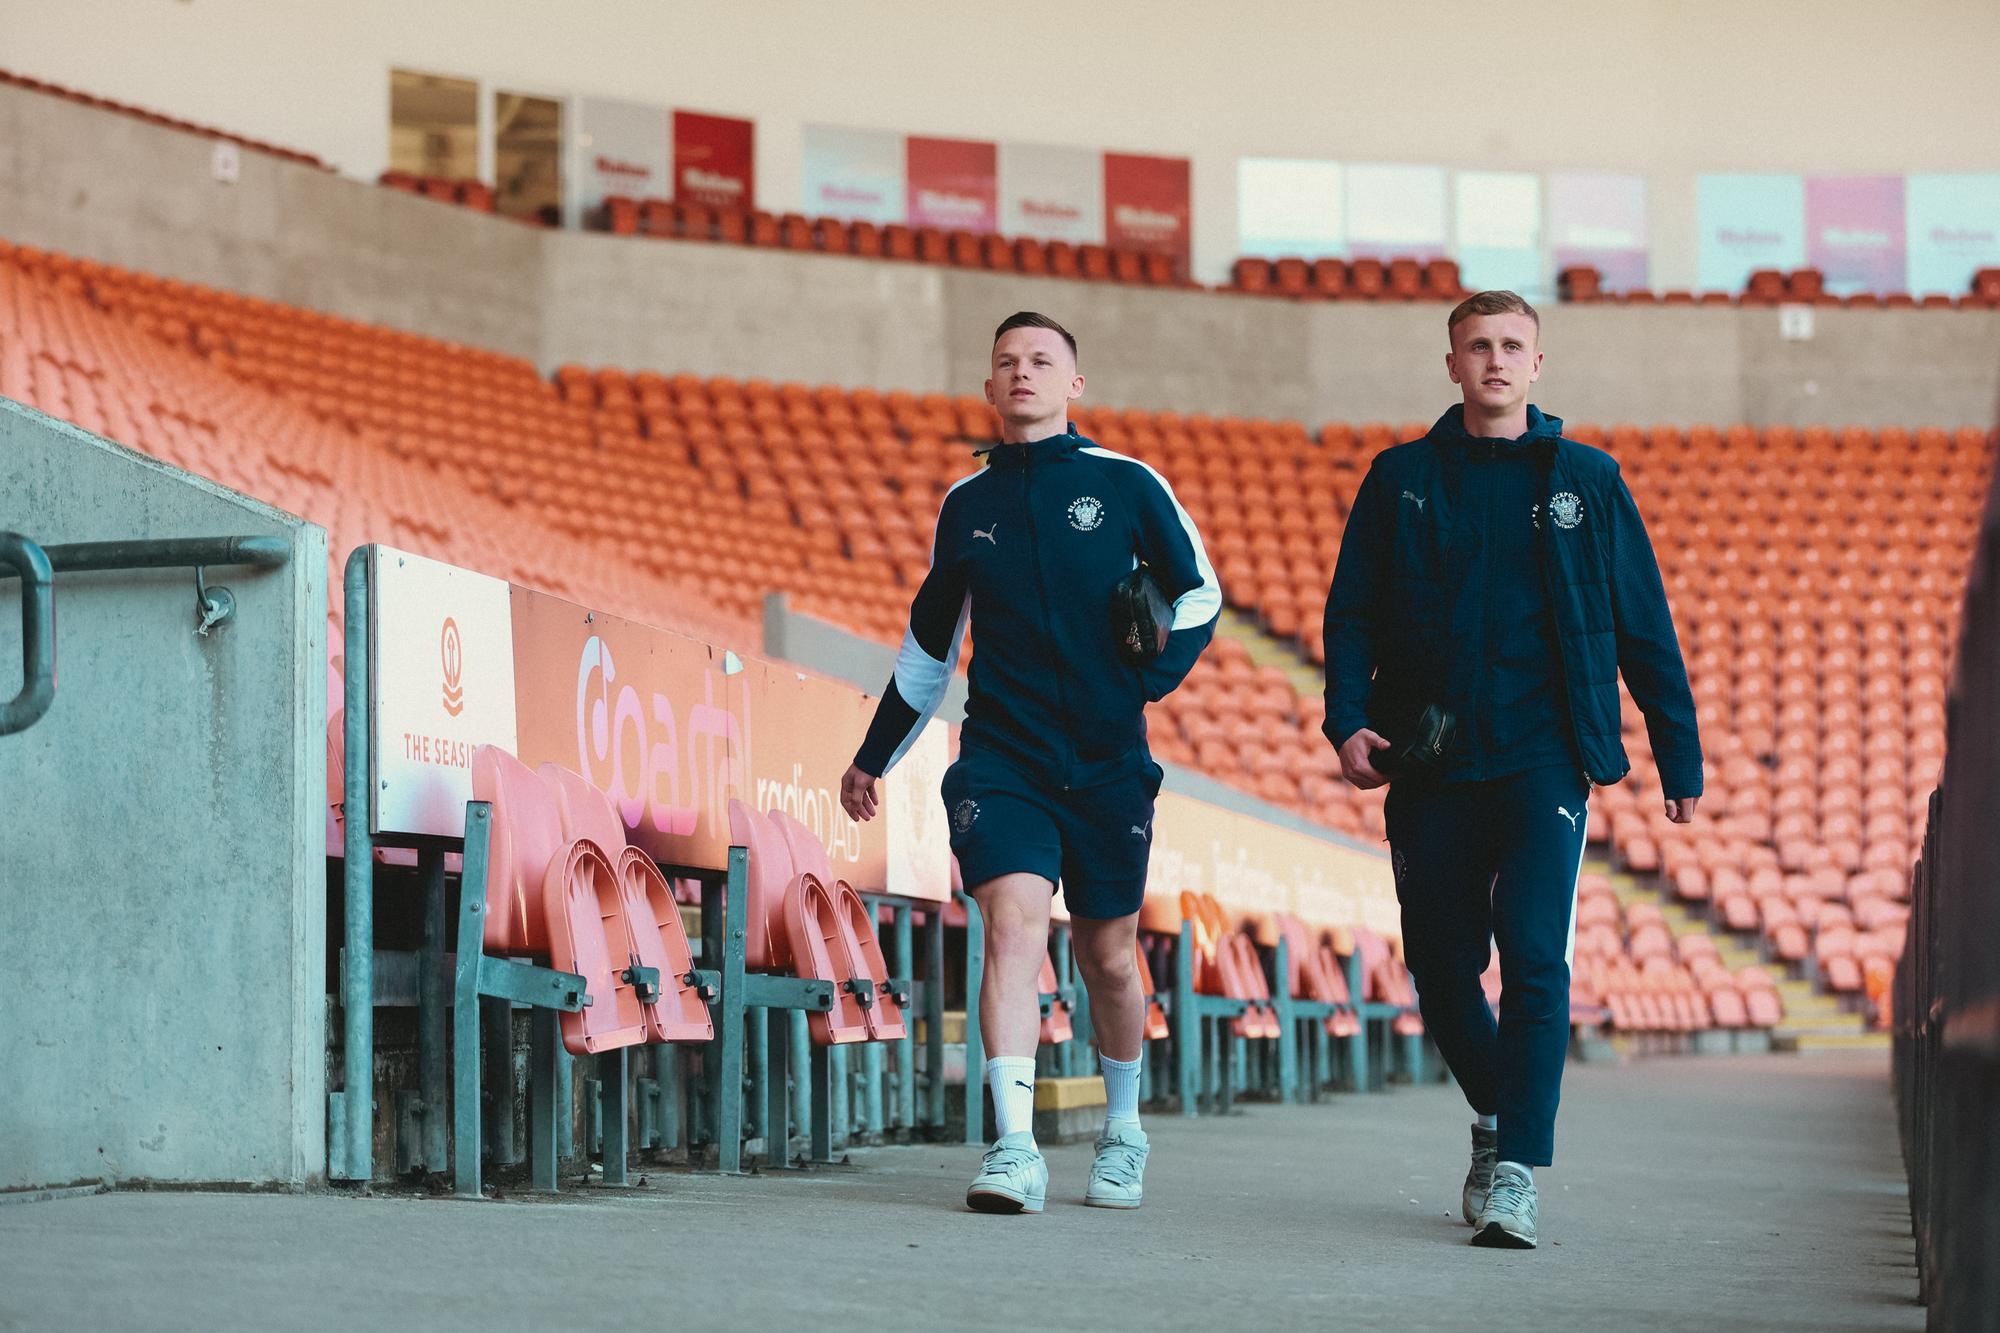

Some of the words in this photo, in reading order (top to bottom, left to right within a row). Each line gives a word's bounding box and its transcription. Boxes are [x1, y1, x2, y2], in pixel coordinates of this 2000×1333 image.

[1068, 497, 1103, 513] BLACKPOOL
[1549, 492, 1582, 508] BLACKPOOL
[404, 732, 431, 763] THE
[576, 635, 752, 840] Coastal
